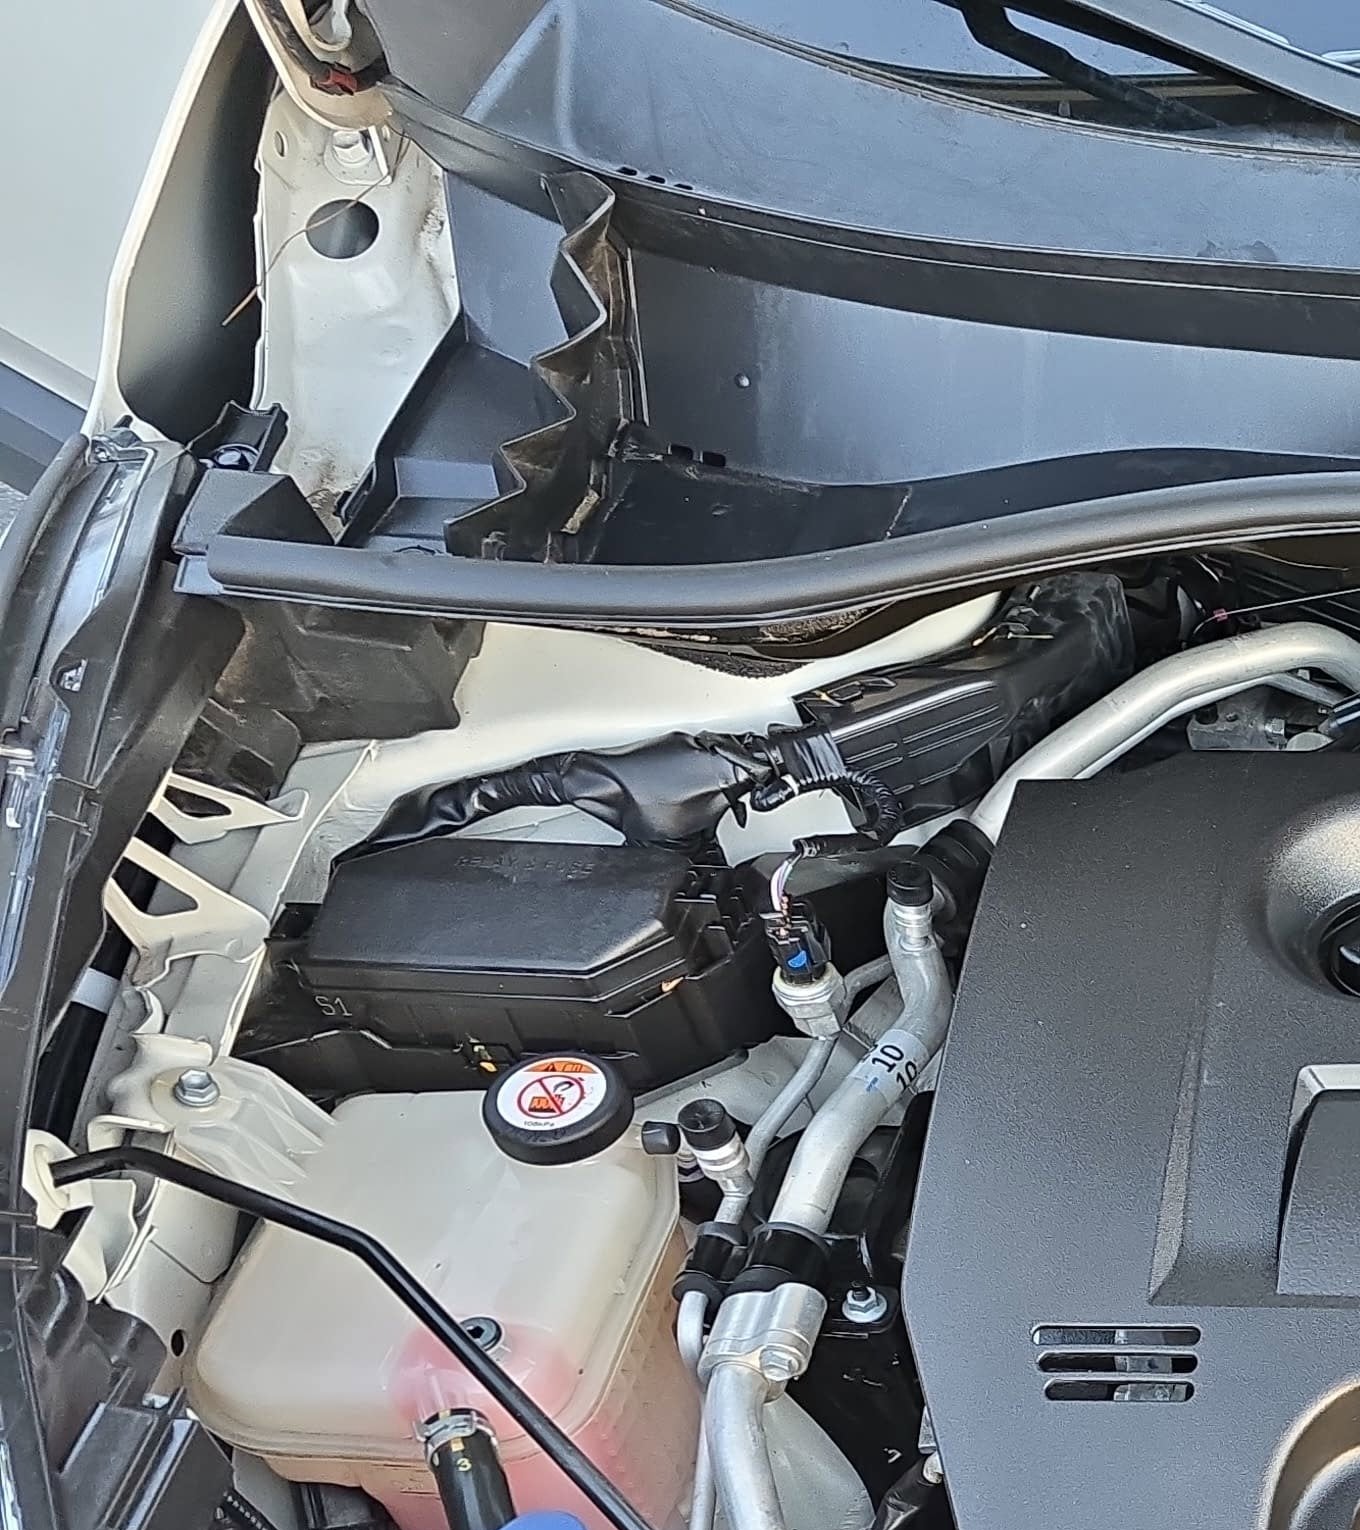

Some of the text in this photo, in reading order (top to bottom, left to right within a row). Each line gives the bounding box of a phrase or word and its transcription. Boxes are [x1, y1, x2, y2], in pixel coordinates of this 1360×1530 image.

[315, 995, 353, 1016] S1
[872, 1044, 904, 1073] 10
[457, 1457, 472, 1472] 3
